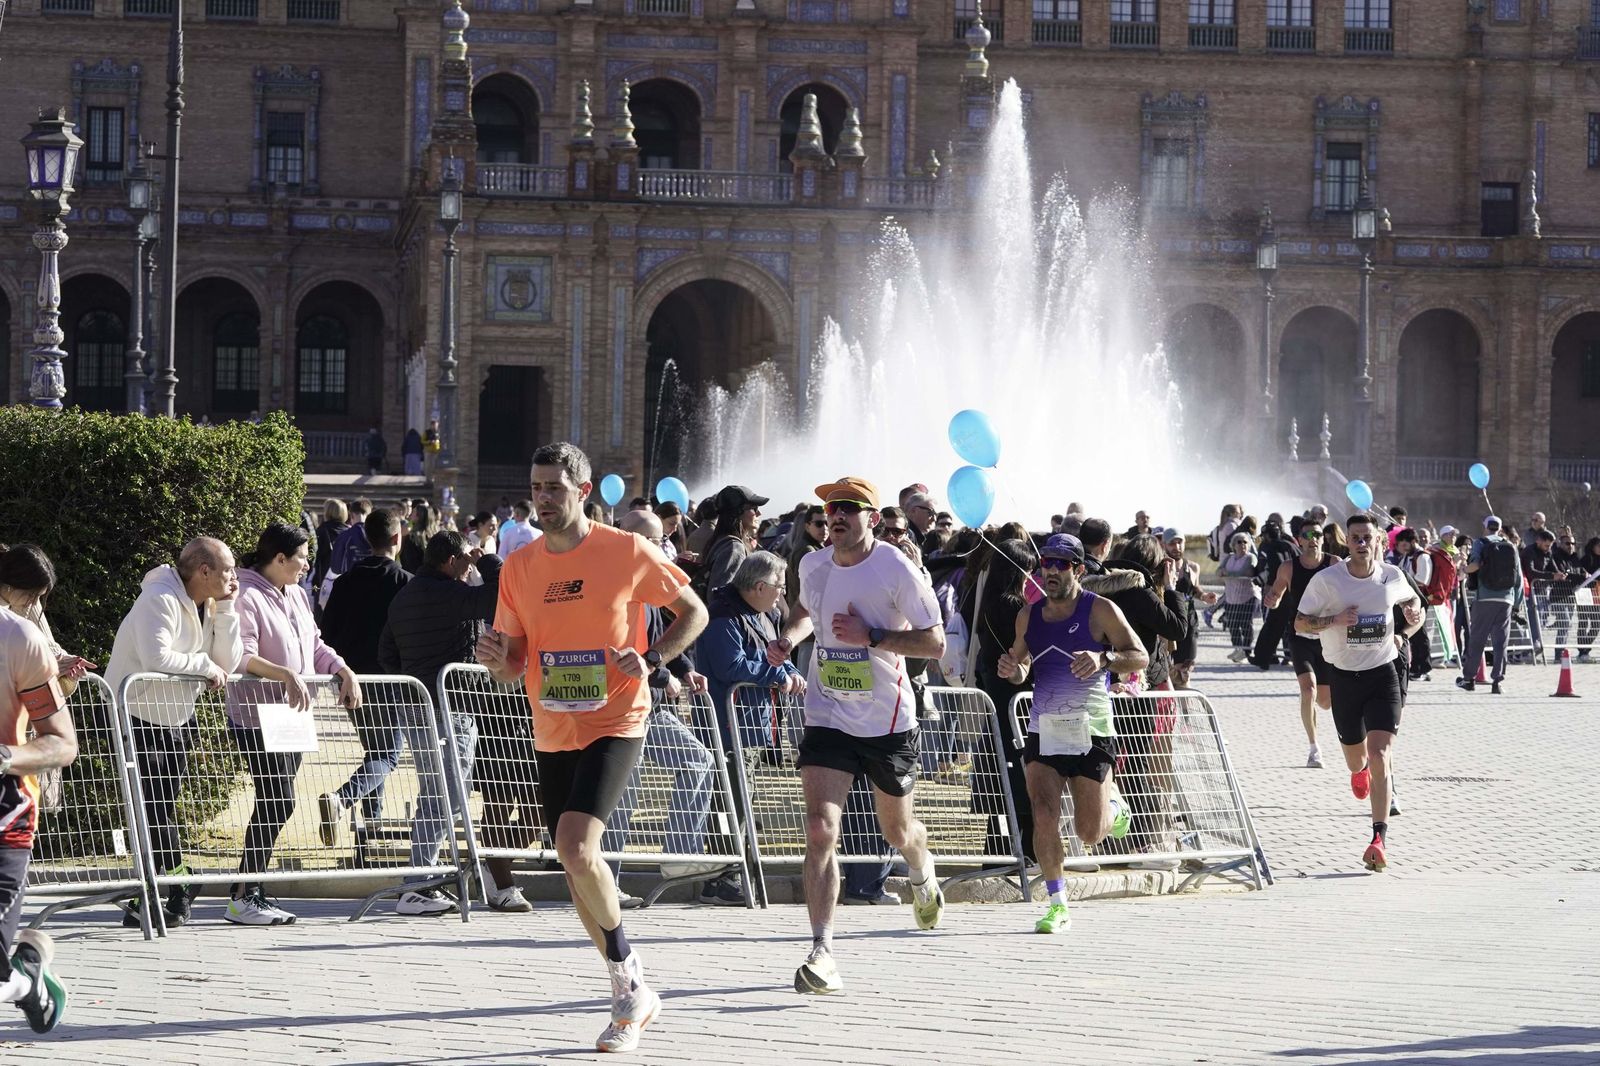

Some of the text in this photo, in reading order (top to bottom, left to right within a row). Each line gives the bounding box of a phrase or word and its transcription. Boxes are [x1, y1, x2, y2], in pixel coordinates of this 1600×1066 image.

[1361, 616, 1383, 624] ZURICH
[559, 654, 596, 664] ZURICH
[830, 651, 862, 660] ZURICH
[562, 674, 581, 682] 1709
[828, 675, 862, 689] VICTOR
[546, 685, 600, 699] ANTONIO
